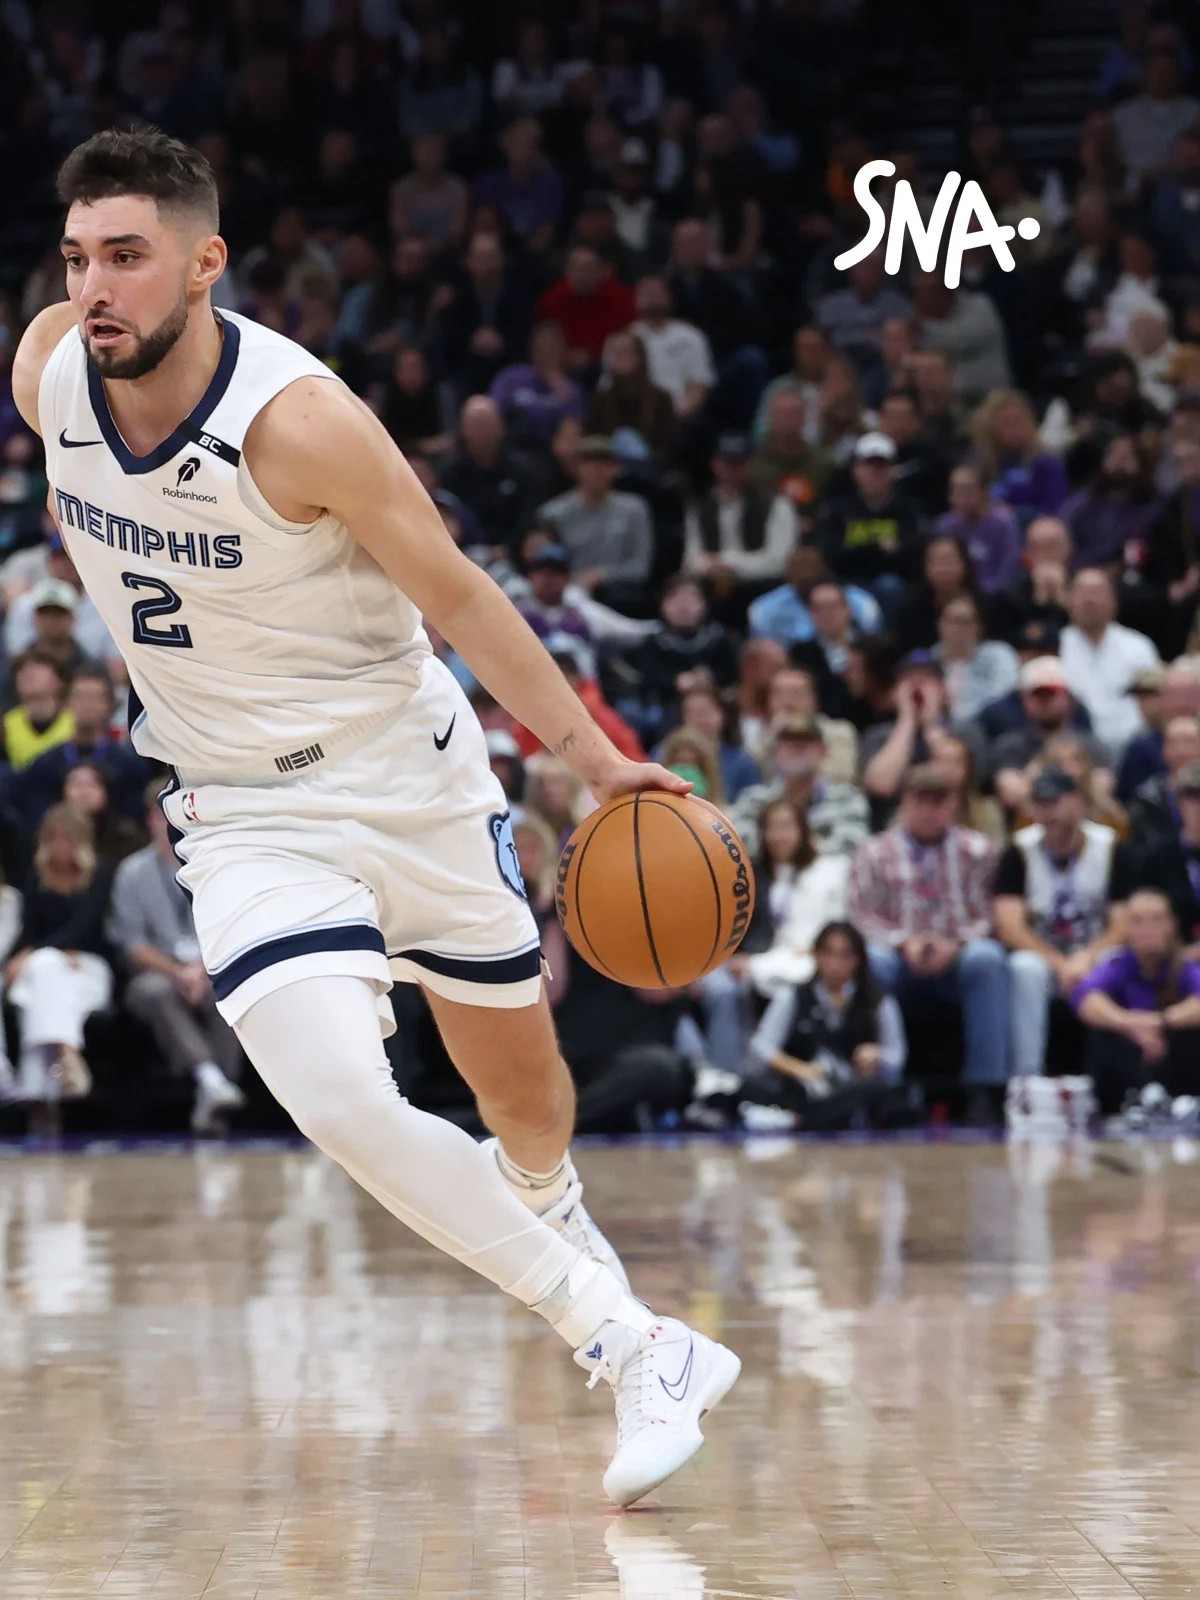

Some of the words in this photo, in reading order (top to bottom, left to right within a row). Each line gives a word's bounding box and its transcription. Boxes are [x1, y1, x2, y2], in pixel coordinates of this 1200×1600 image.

[199, 434, 221, 453] BC
[56, 487, 243, 569] MEMPHIS
[162, 487, 218, 504] Robinhood
[121, 571, 194, 648] 2
[711, 820, 750, 951] Wilson
